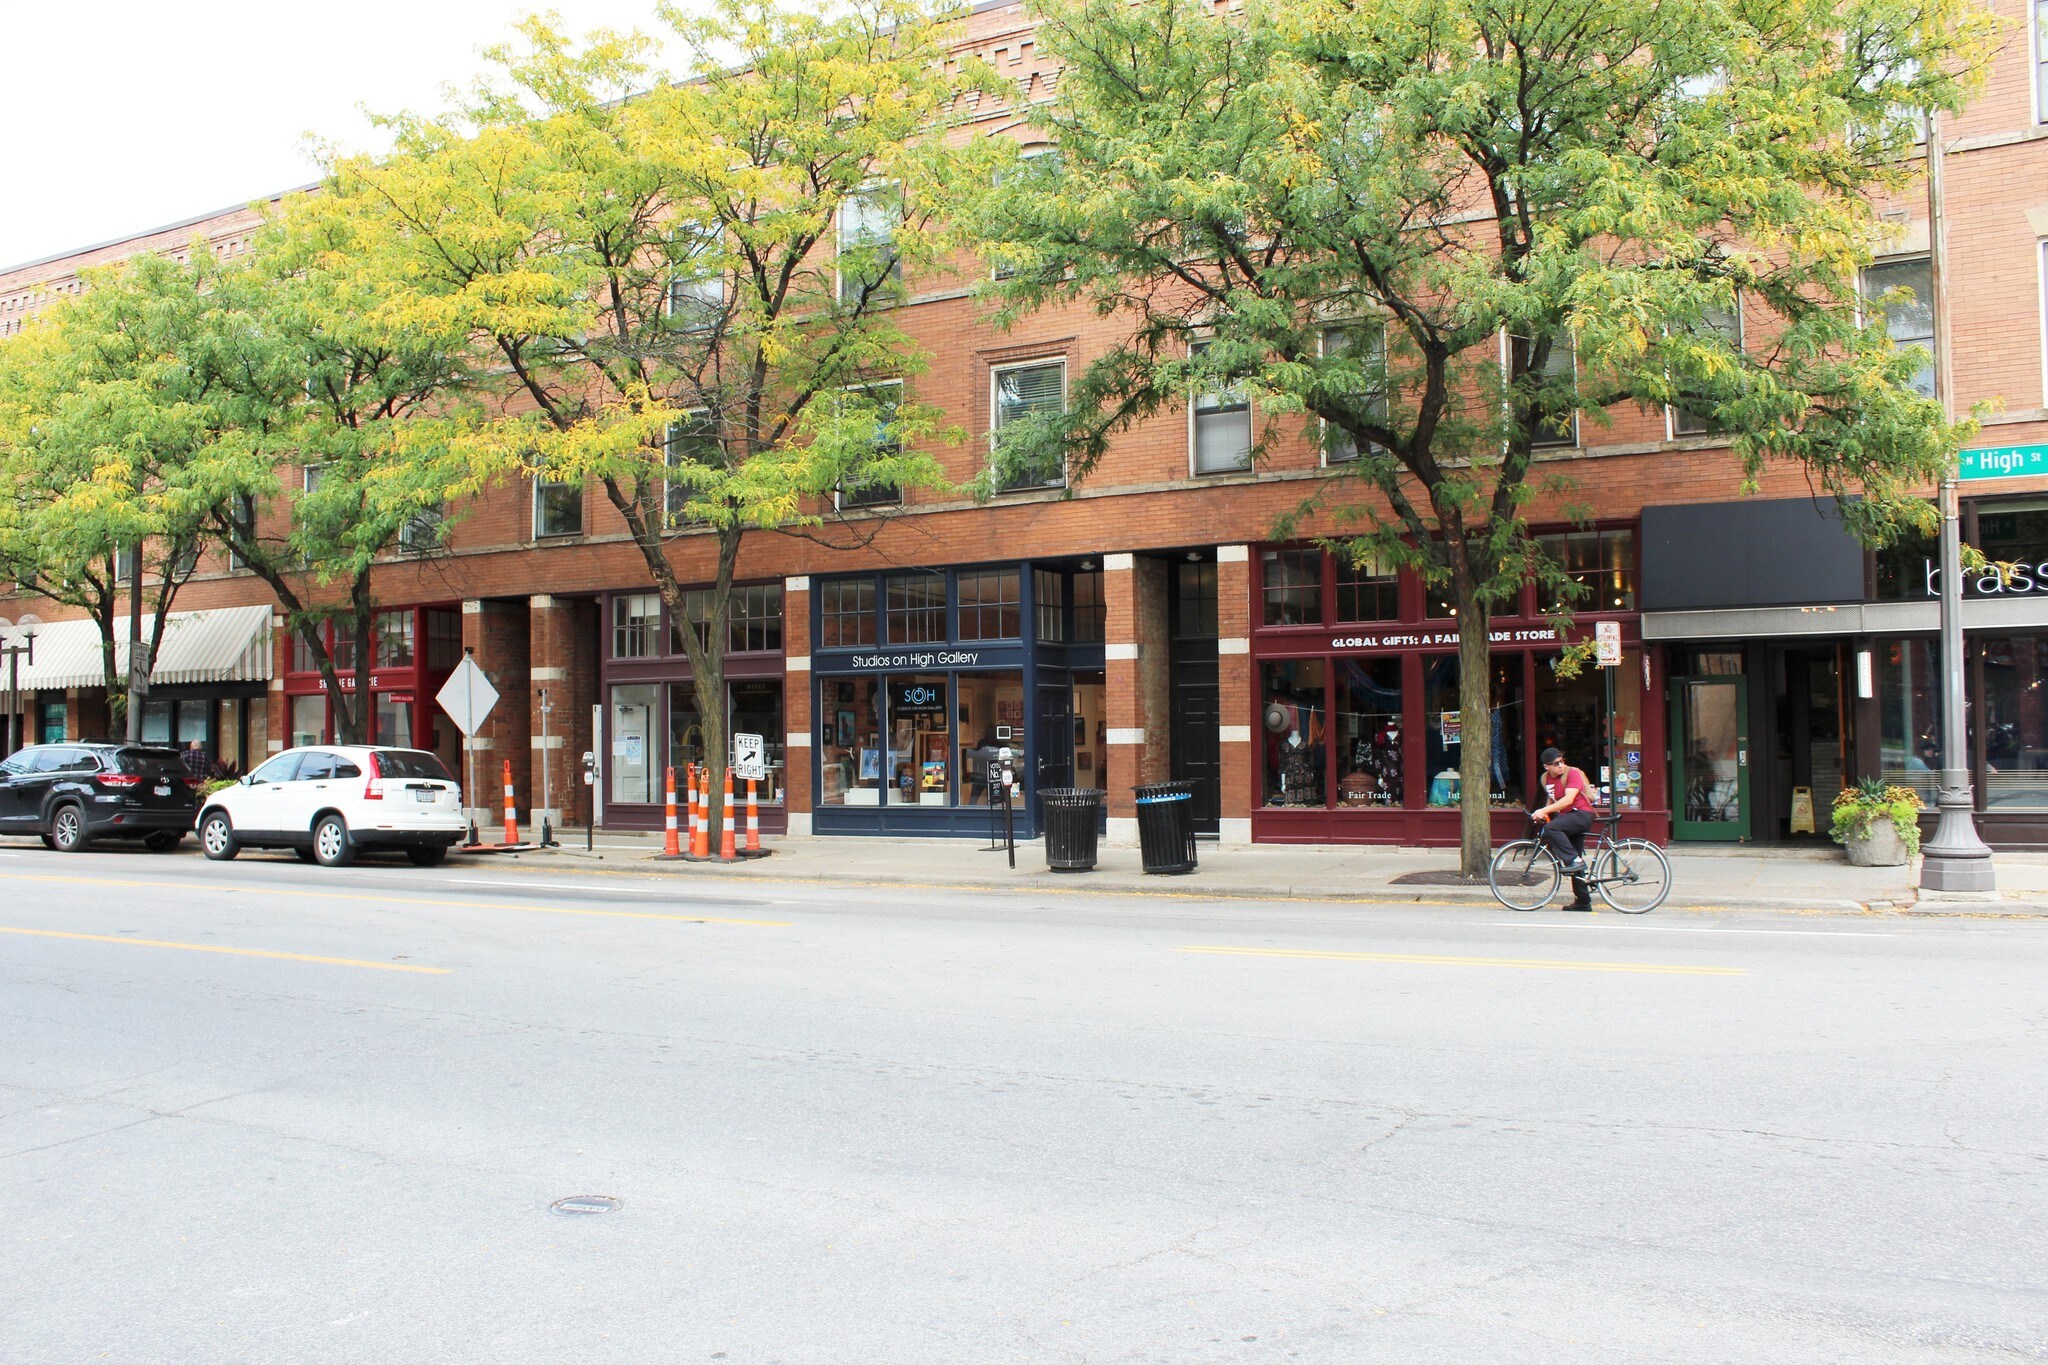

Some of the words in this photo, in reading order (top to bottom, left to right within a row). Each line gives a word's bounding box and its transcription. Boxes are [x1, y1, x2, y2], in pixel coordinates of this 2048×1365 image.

[1966, 456, 1973, 465] N
[1980, 450, 2024, 473] High
[2030, 452, 2042, 462] St
[1332, 637, 1378, 648] GLOBAL
[1382, 635, 1419, 646] GIFTS:
[1421, 634, 1432, 644] A
[1515, 629, 1556, 641] STORE
[852, 655, 890, 668] Studios
[892, 656, 908, 666] on
[910, 652, 935, 668] High
[937, 651, 978, 666] Gallery
[347, 676, 378, 688] GAIE
[904, 687, 935, 705] SOH
[738, 738, 760, 749] KEEP
[738, 764, 762, 775] RIGHT
[1348, 791, 1365, 799] Fair
[1366, 791, 1392, 799] Trade
[1447, 791, 1506, 799] Intonal
